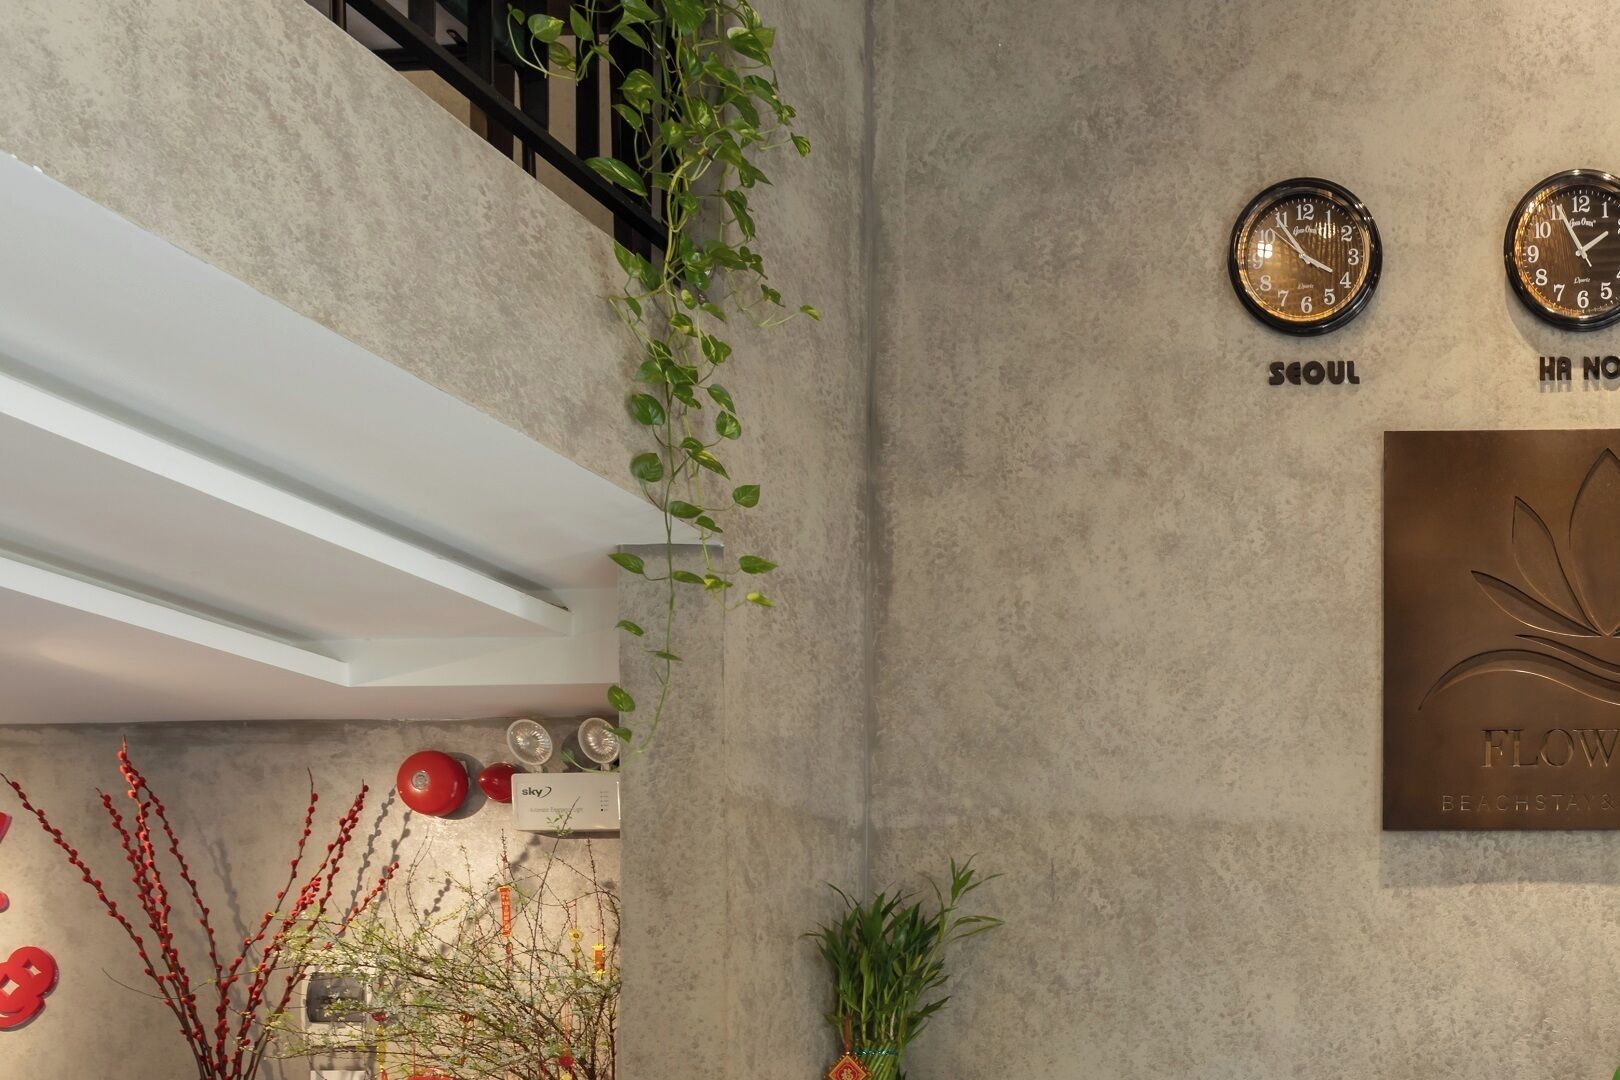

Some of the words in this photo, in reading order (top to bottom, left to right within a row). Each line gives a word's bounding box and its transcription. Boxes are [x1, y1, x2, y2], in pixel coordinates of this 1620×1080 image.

[1296, 204, 1314, 220] 12
[1572, 196, 1590, 213] 12
[1601, 202, 1609, 218] 1
[1275, 212, 1288, 228] 11
[1325, 210, 1332, 225] 1
[1260, 228, 1275, 245] 10
[1341, 226, 1353, 242] 2
[1534, 222, 1551, 239] 10
[1252, 251, 1264, 269] 9
[1348, 248, 1359, 265] 3
[1527, 246, 1539, 263] 9
[1260, 275, 1272, 291] 8
[1340, 272, 1352, 288] 4
[1536, 269, 1547, 286] 8
[1278, 290, 1289, 306] 7
[1324, 289, 1335, 305] 5
[1554, 284, 1565, 301] 7
[1601, 282, 1612, 299] 5
[1301, 297, 1312, 313] 6
[1577, 291, 1589, 308] 6
[1268, 360, 1360, 386] SEOUL
[1539, 356, 1572, 381] HA
[521, 787, 543, 798] sky
